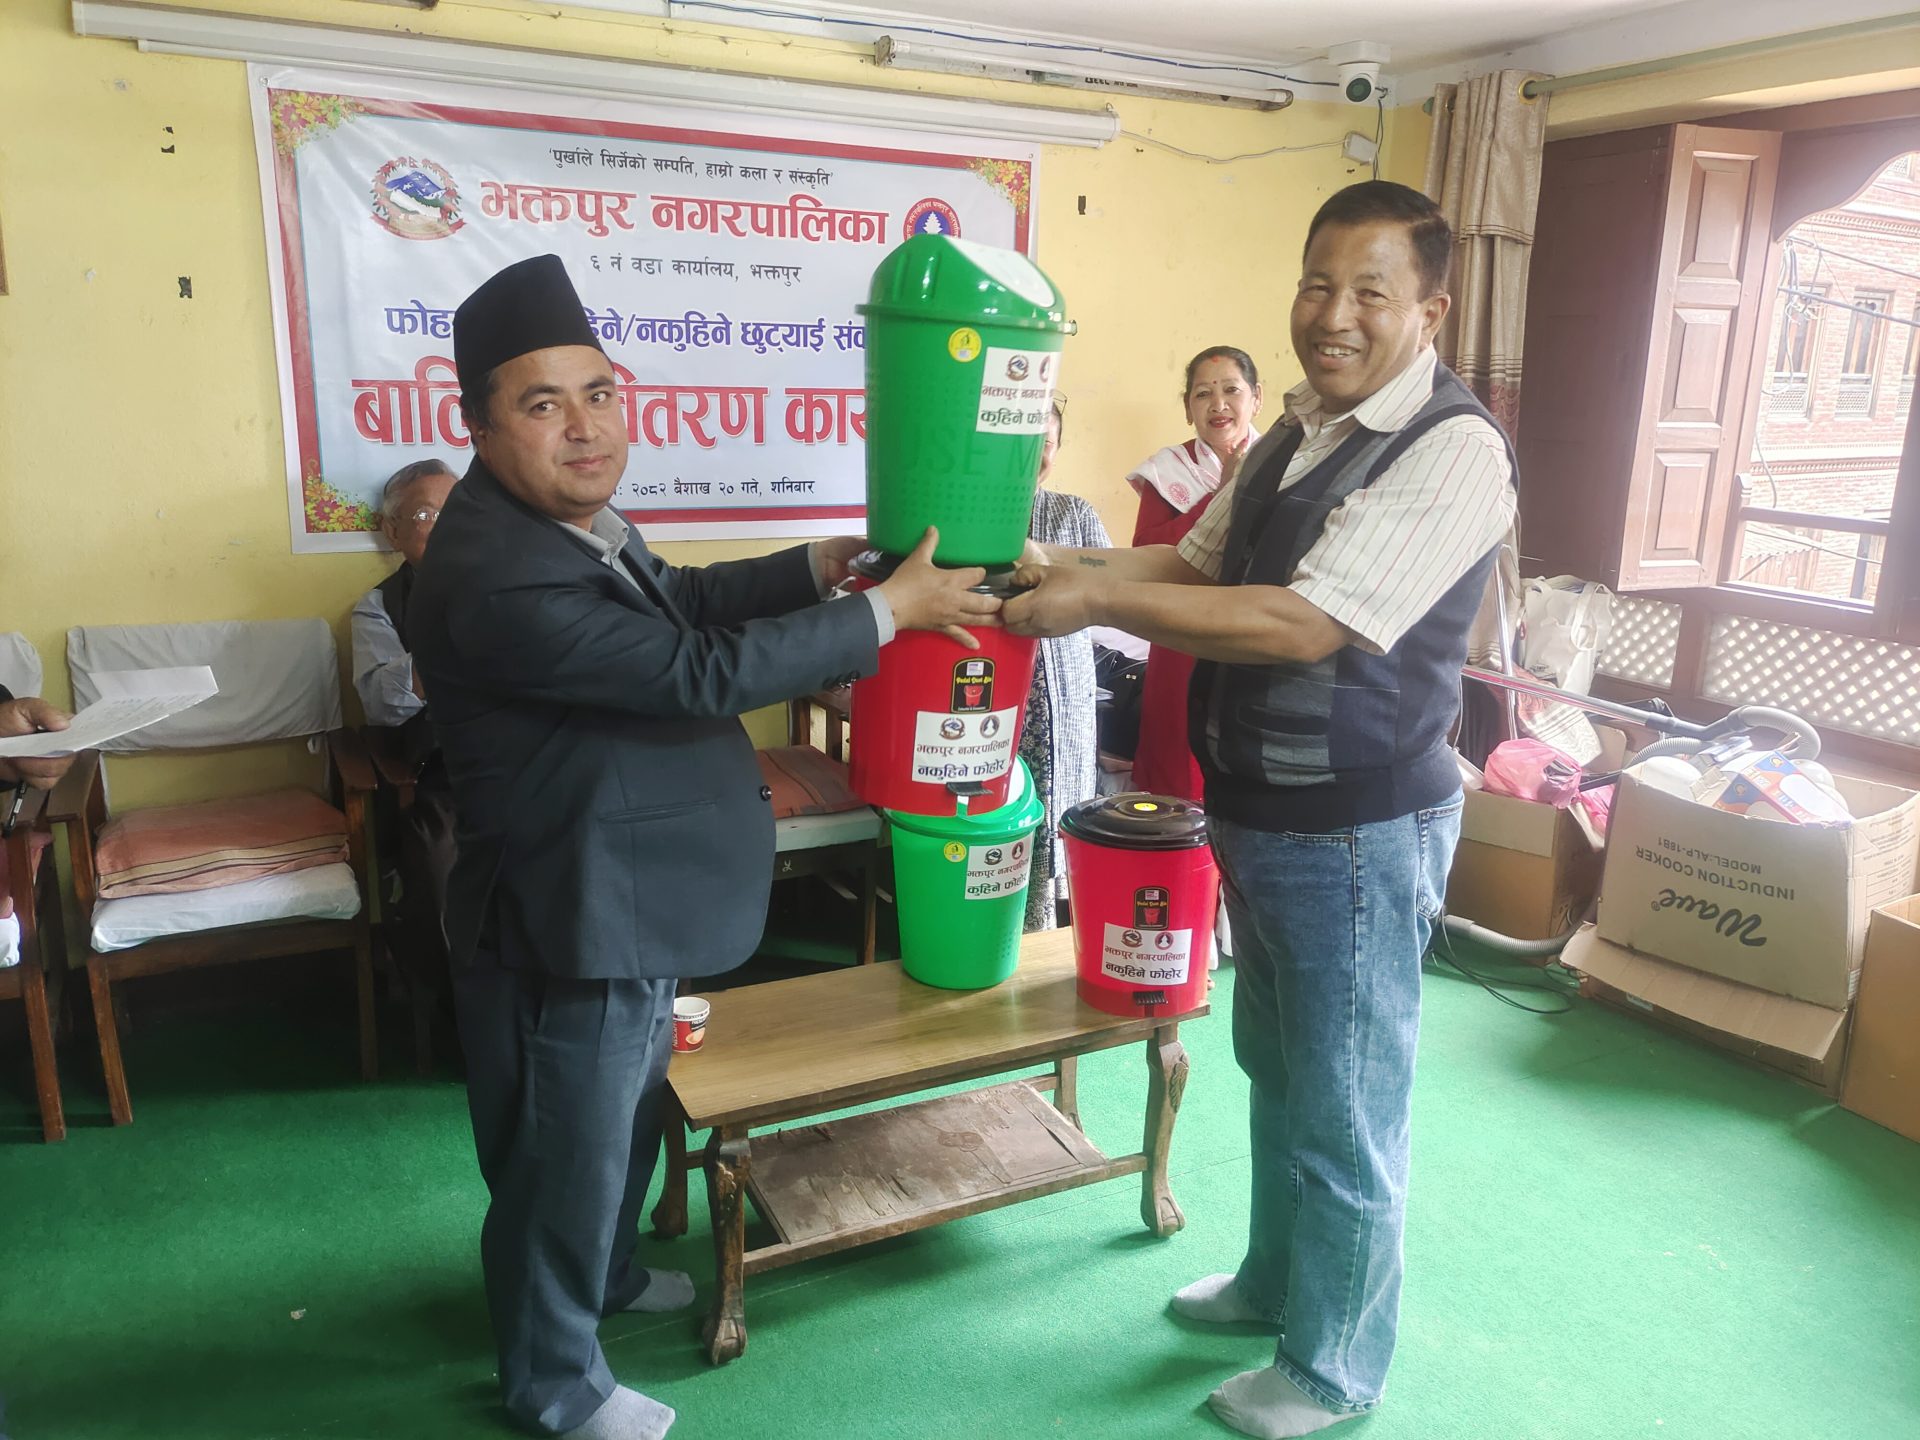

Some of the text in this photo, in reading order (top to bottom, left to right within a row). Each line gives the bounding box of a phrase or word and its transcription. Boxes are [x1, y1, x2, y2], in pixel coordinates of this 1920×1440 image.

[705, 160, 733, 178] हाम्रो
[740, 165, 767, 180] कला
[774, 169, 783, 183] र
[480, 181, 637, 237] भक्तपुर
[650, 193, 890, 244] नगरपालिका
[590, 253, 802, 287] ६ नं वडा कार्यालय, भक्तपुर
[384, 299, 457, 339] फोह
[981, 408, 1024, 426] कुहिने
[632, 483, 667, 496] २०८२
[674, 477, 711, 496] बैशाख
[719, 483, 734, 495] २०
[771, 476, 815, 495] शनिबार
[917, 739, 1010, 757] भक्तपुर नगरपालिका
[918, 759, 1005, 780] नकुहिने फोहोर
[1635, 845, 1795, 901] INDUCTION COOKER
[967, 882, 1001, 896] कुहिने
[1136, 952, 1186, 962] नगरपालिका
[1105, 962, 1183, 979] नकुहिने फोहोर
